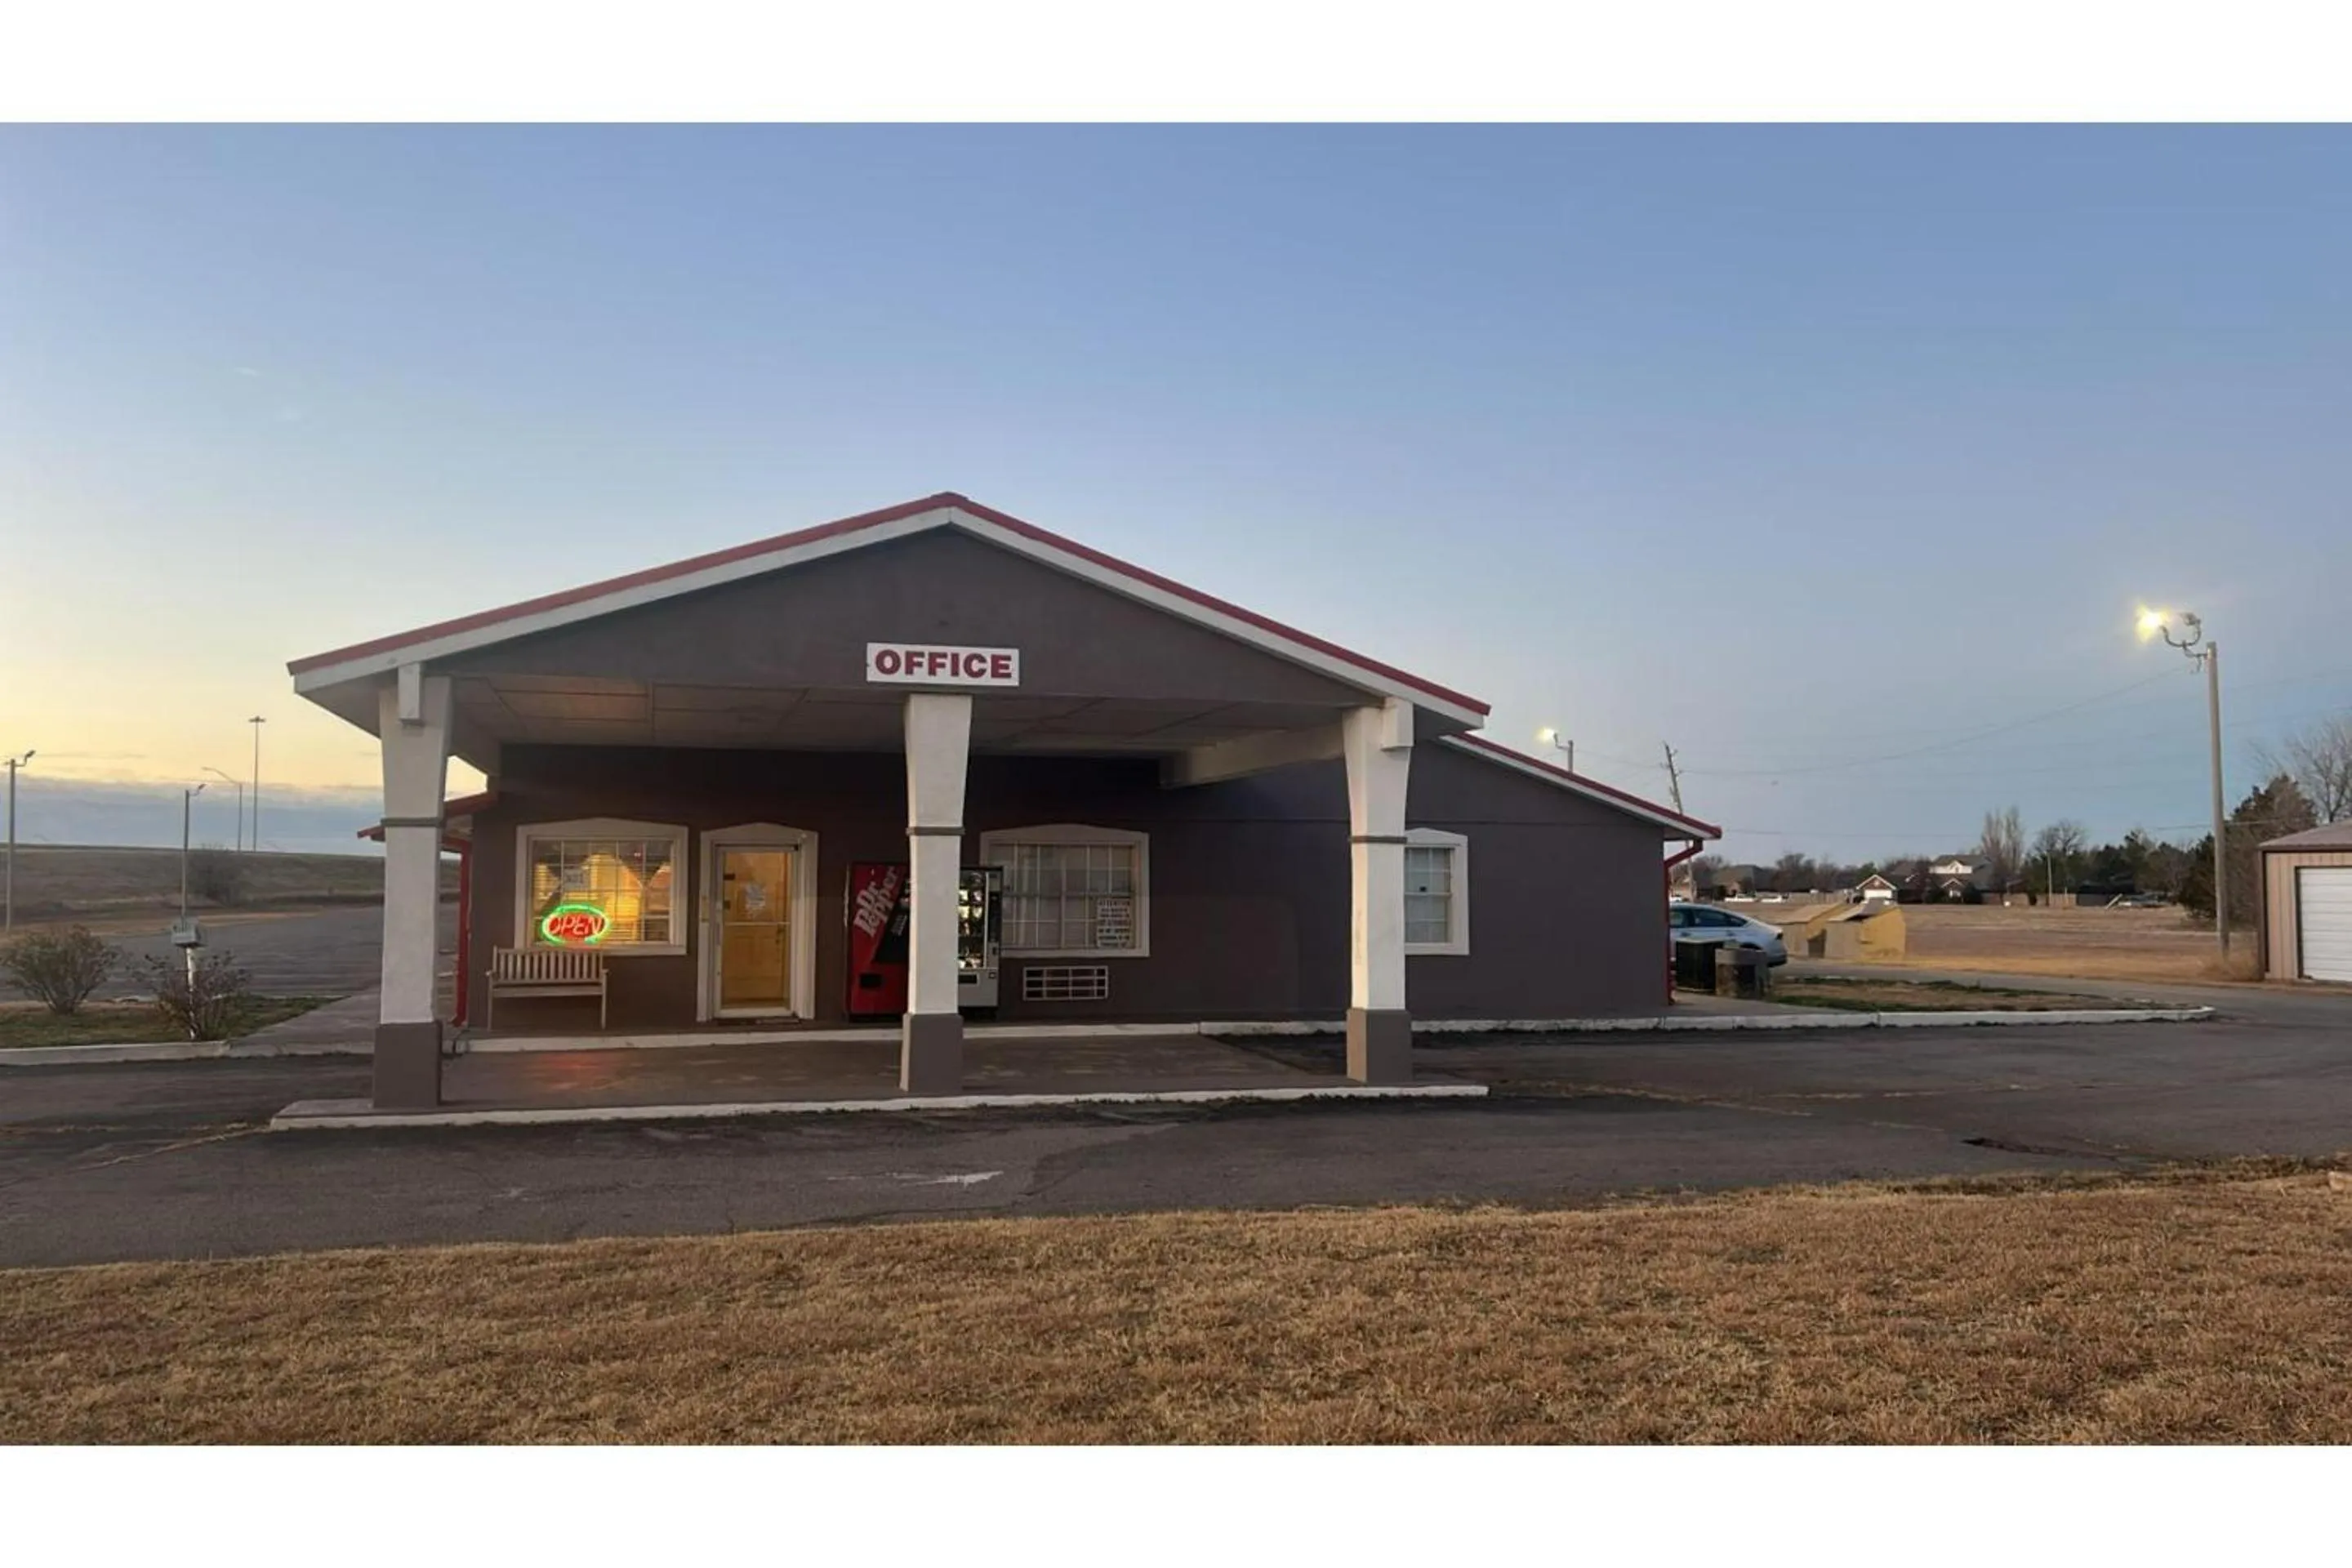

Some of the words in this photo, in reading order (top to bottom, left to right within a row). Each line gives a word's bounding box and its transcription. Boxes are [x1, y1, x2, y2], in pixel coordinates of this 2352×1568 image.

[875, 649, 1012, 679] OFFICE
[853, 866, 898, 938] Pepper
[548, 914, 603, 936] OPEN
